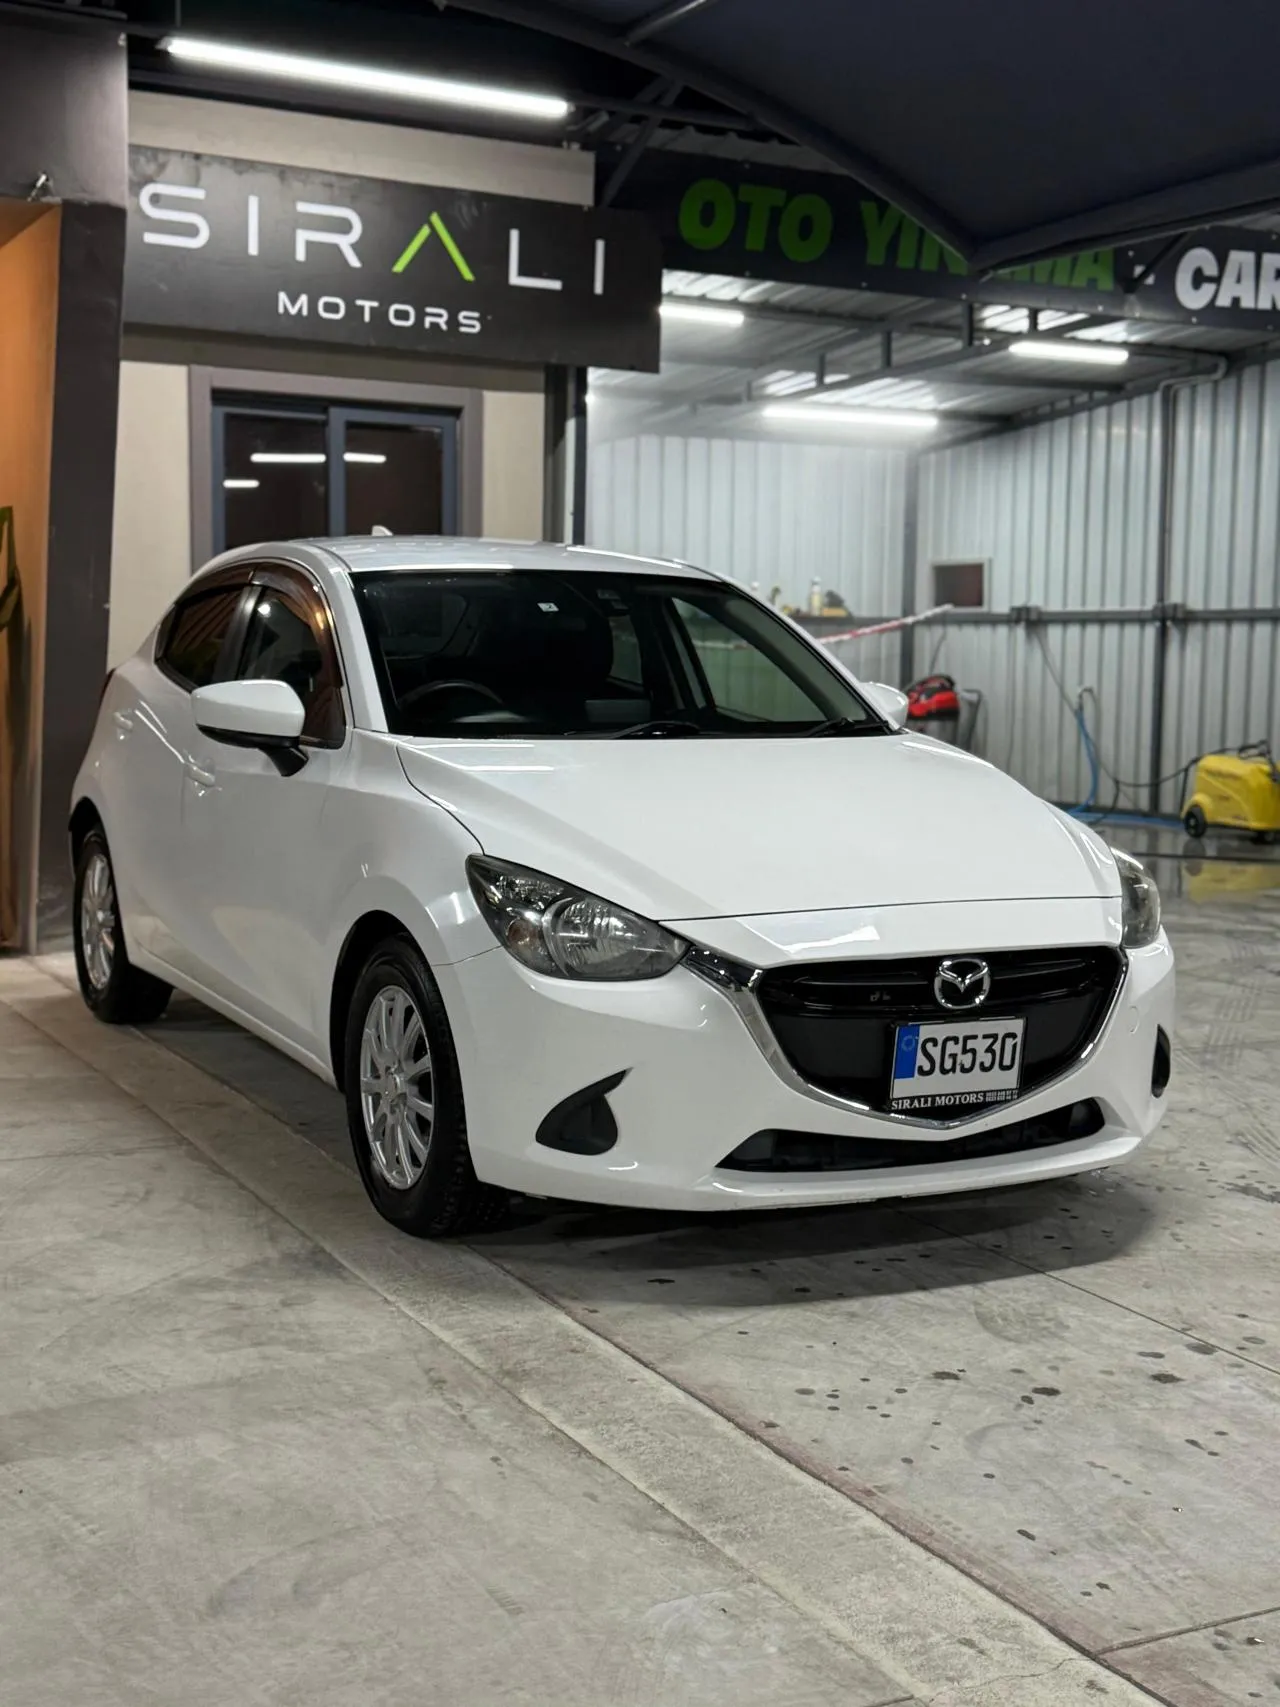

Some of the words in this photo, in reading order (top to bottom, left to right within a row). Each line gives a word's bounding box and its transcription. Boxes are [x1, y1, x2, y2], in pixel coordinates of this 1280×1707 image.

[138, 182, 605, 295] SIRALI
[678, 178, 833, 263] OTO
[278, 291, 482, 333] MOTORS
[917, 1032, 1018, 1077] SG530
[891, 1097, 932, 1110] SIRALI
[934, 1092, 984, 1107] MOTORS
